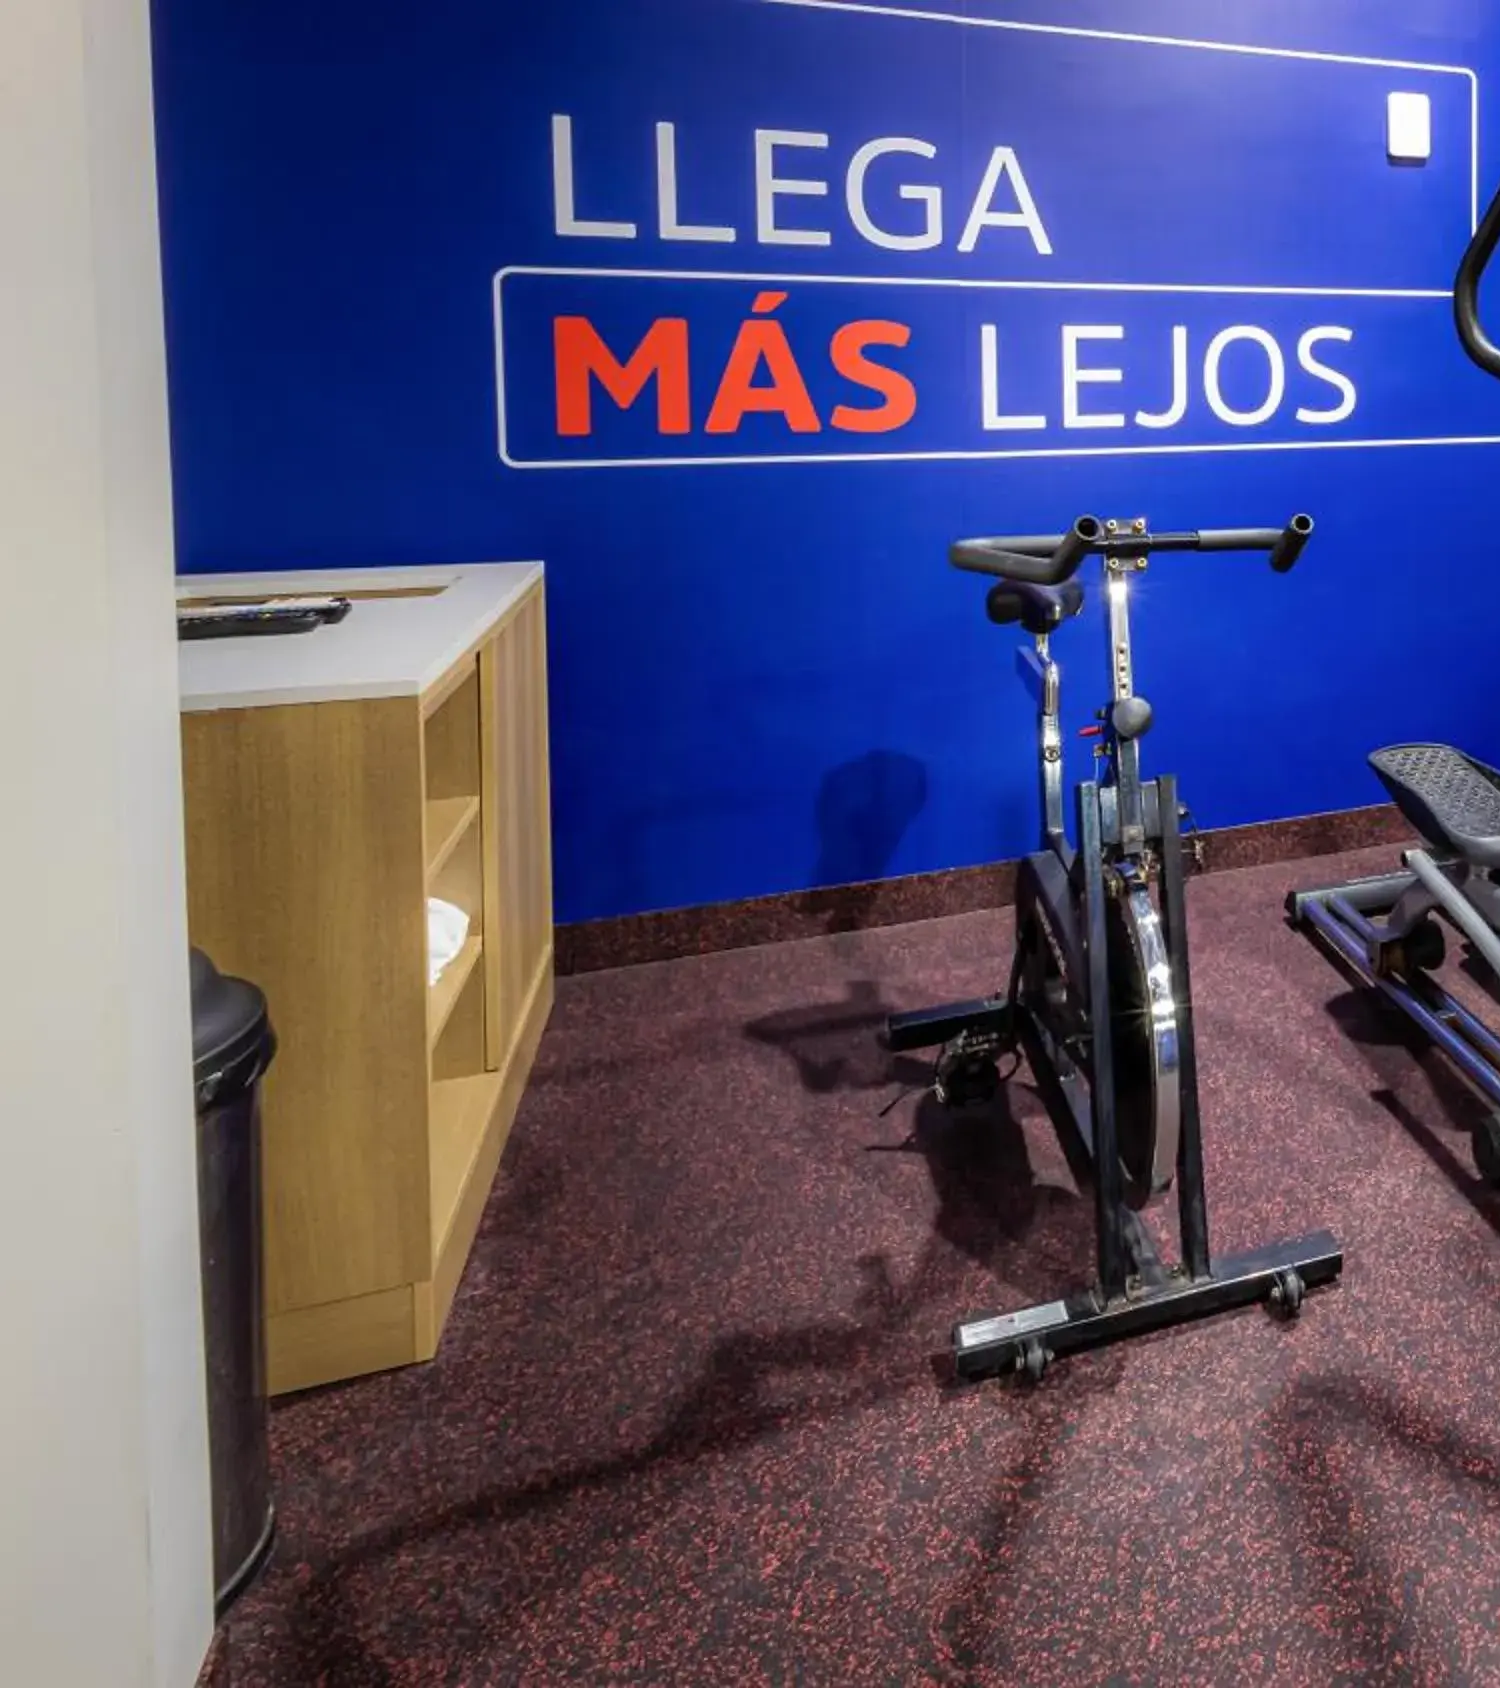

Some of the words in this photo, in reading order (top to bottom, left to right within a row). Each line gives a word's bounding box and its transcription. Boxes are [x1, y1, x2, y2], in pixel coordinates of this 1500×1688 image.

[551, 113, 1053, 255] LLEGA
[553, 291, 918, 437] MÁS
[980, 323, 1357, 430] LEJOS
